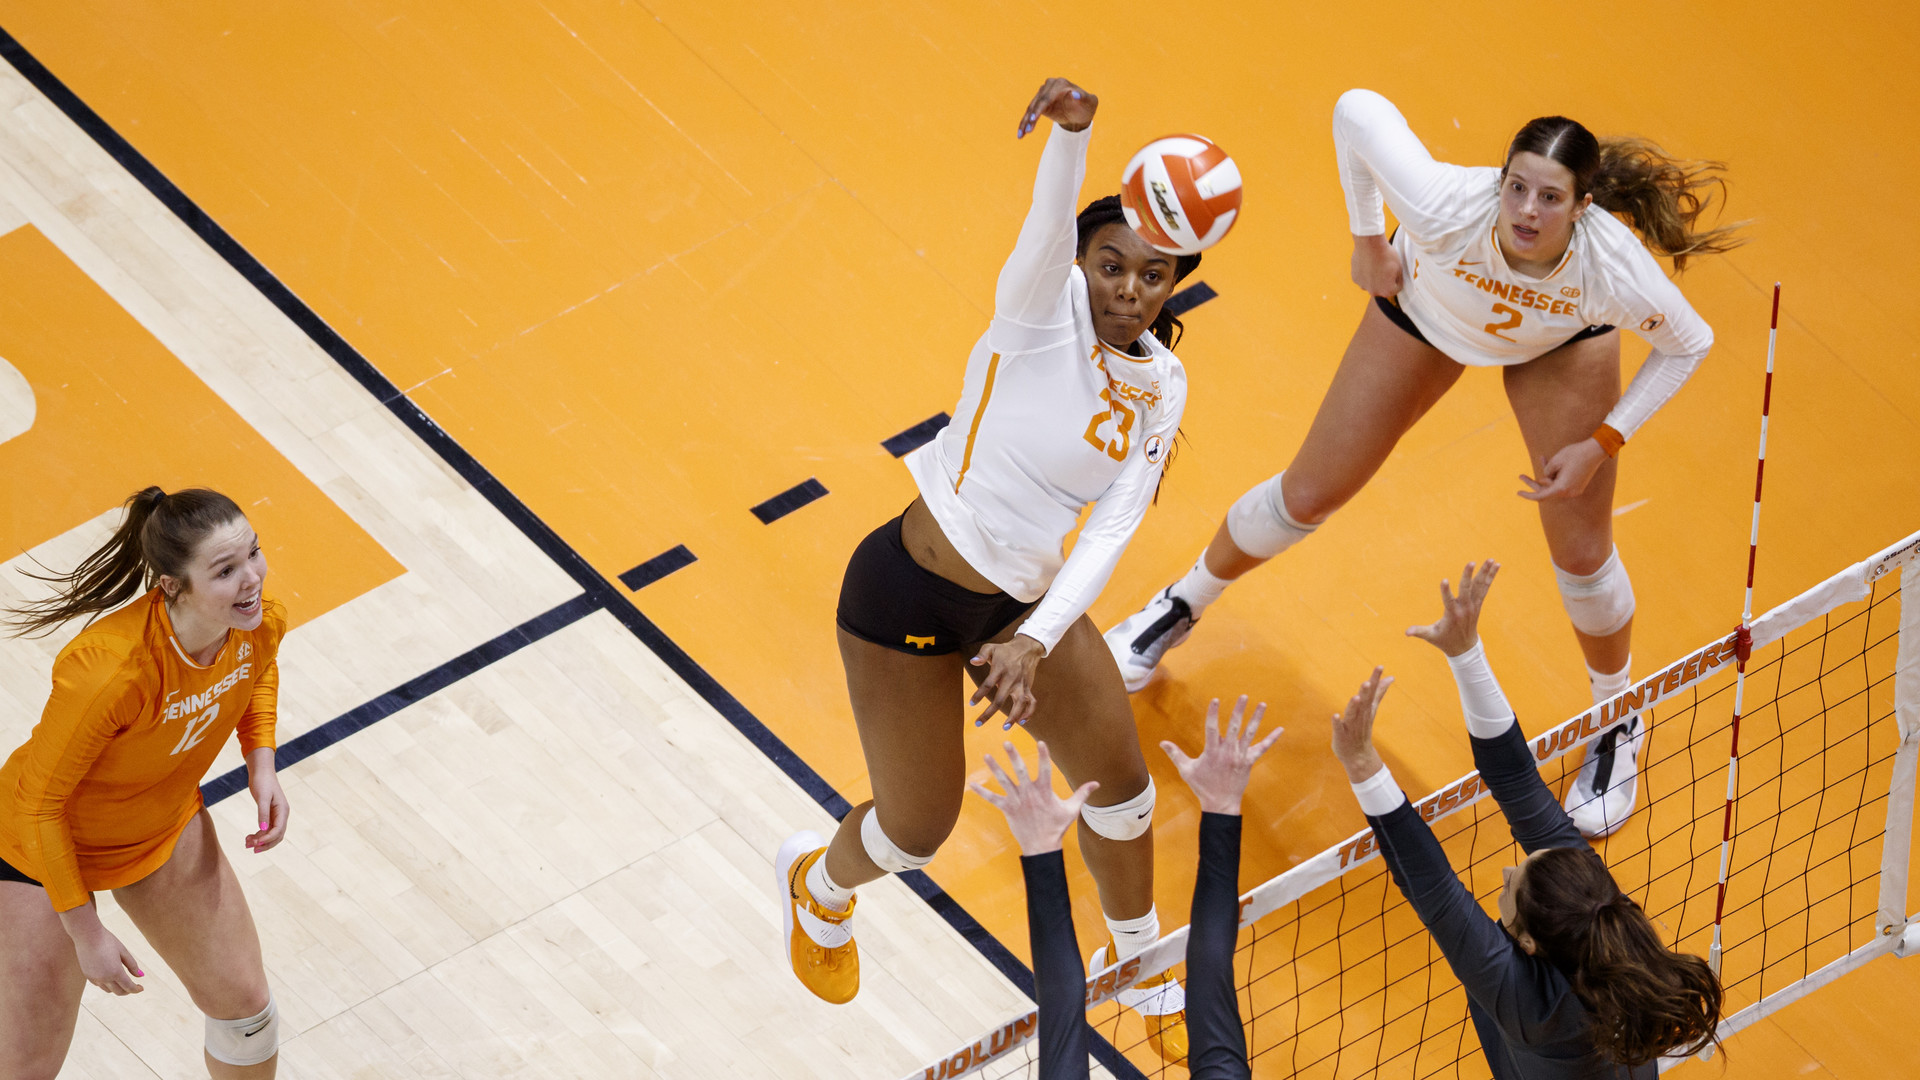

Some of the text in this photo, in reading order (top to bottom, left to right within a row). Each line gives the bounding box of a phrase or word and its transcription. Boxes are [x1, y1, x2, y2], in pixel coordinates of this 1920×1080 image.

[1452, 268, 1577, 317] TENNESSEE
[1484, 302, 1523, 343] 2
[1082, 387, 1136, 463] 23
[162, 663, 252, 724] TENNESSEE
[1536, 634, 1738, 761] VOLUNTEERS
[169, 703, 220, 755] 12
